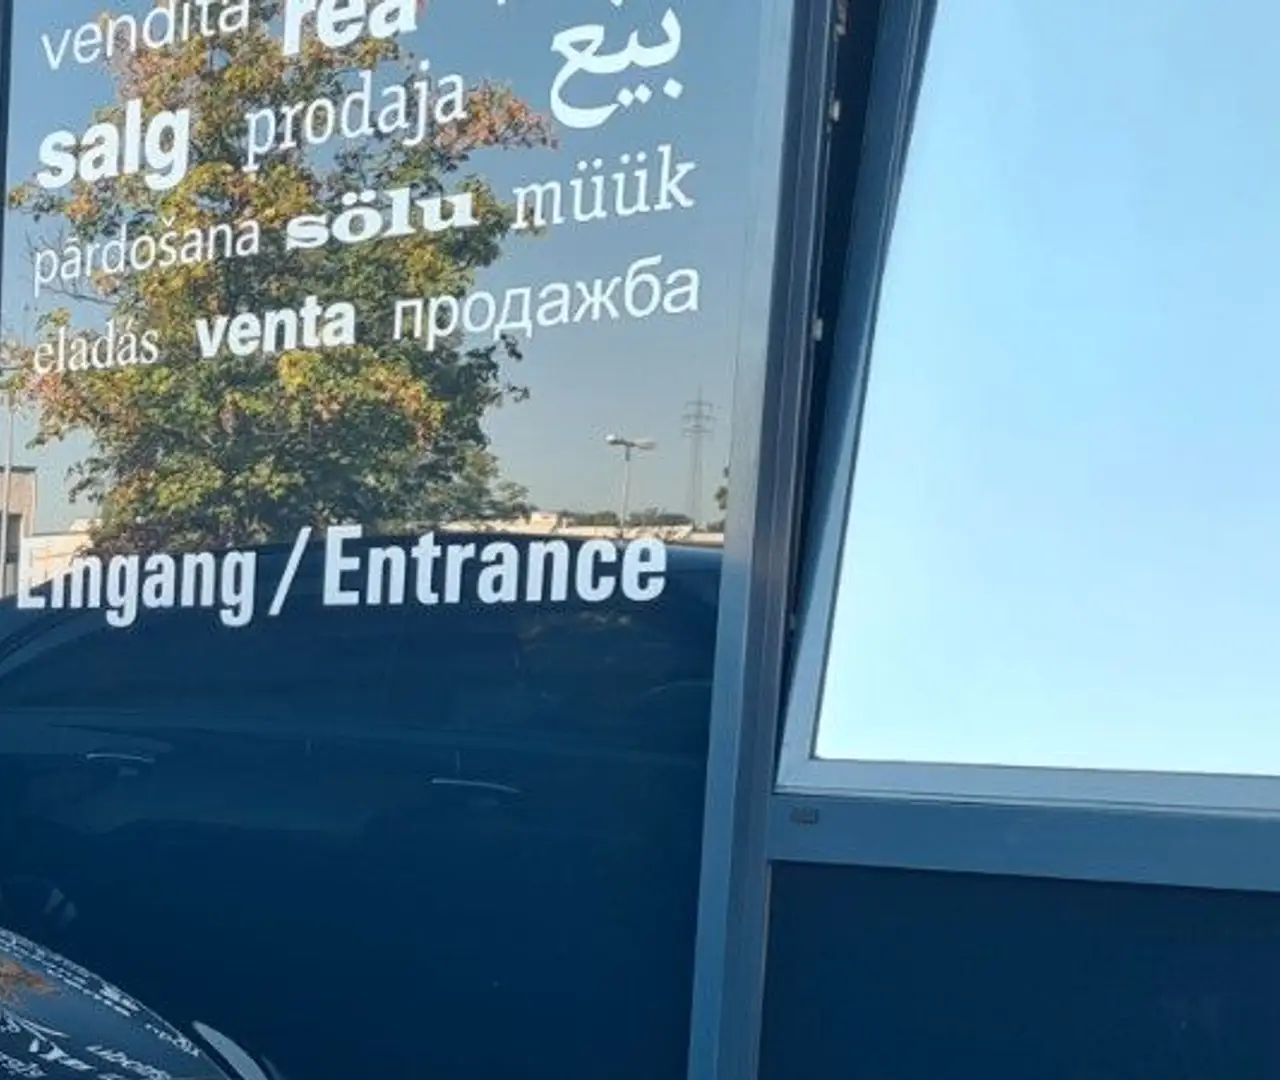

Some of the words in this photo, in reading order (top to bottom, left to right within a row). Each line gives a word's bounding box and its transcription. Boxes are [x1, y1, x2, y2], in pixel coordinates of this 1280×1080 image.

[41, 0, 249, 70] vendita
[36, 98, 191, 191] salg
[242, 60, 467, 173] prodaja
[33, 215, 260, 300] pārdošana
[285, 186, 480, 251] sölu
[510, 144, 697, 230] müük
[33, 320, 160, 376] eladás
[195, 295, 357, 359] venta
[393, 255, 701, 352] продажба
[17, 536, 257, 628] Eingang
[323, 525, 669, 607] Entrance
